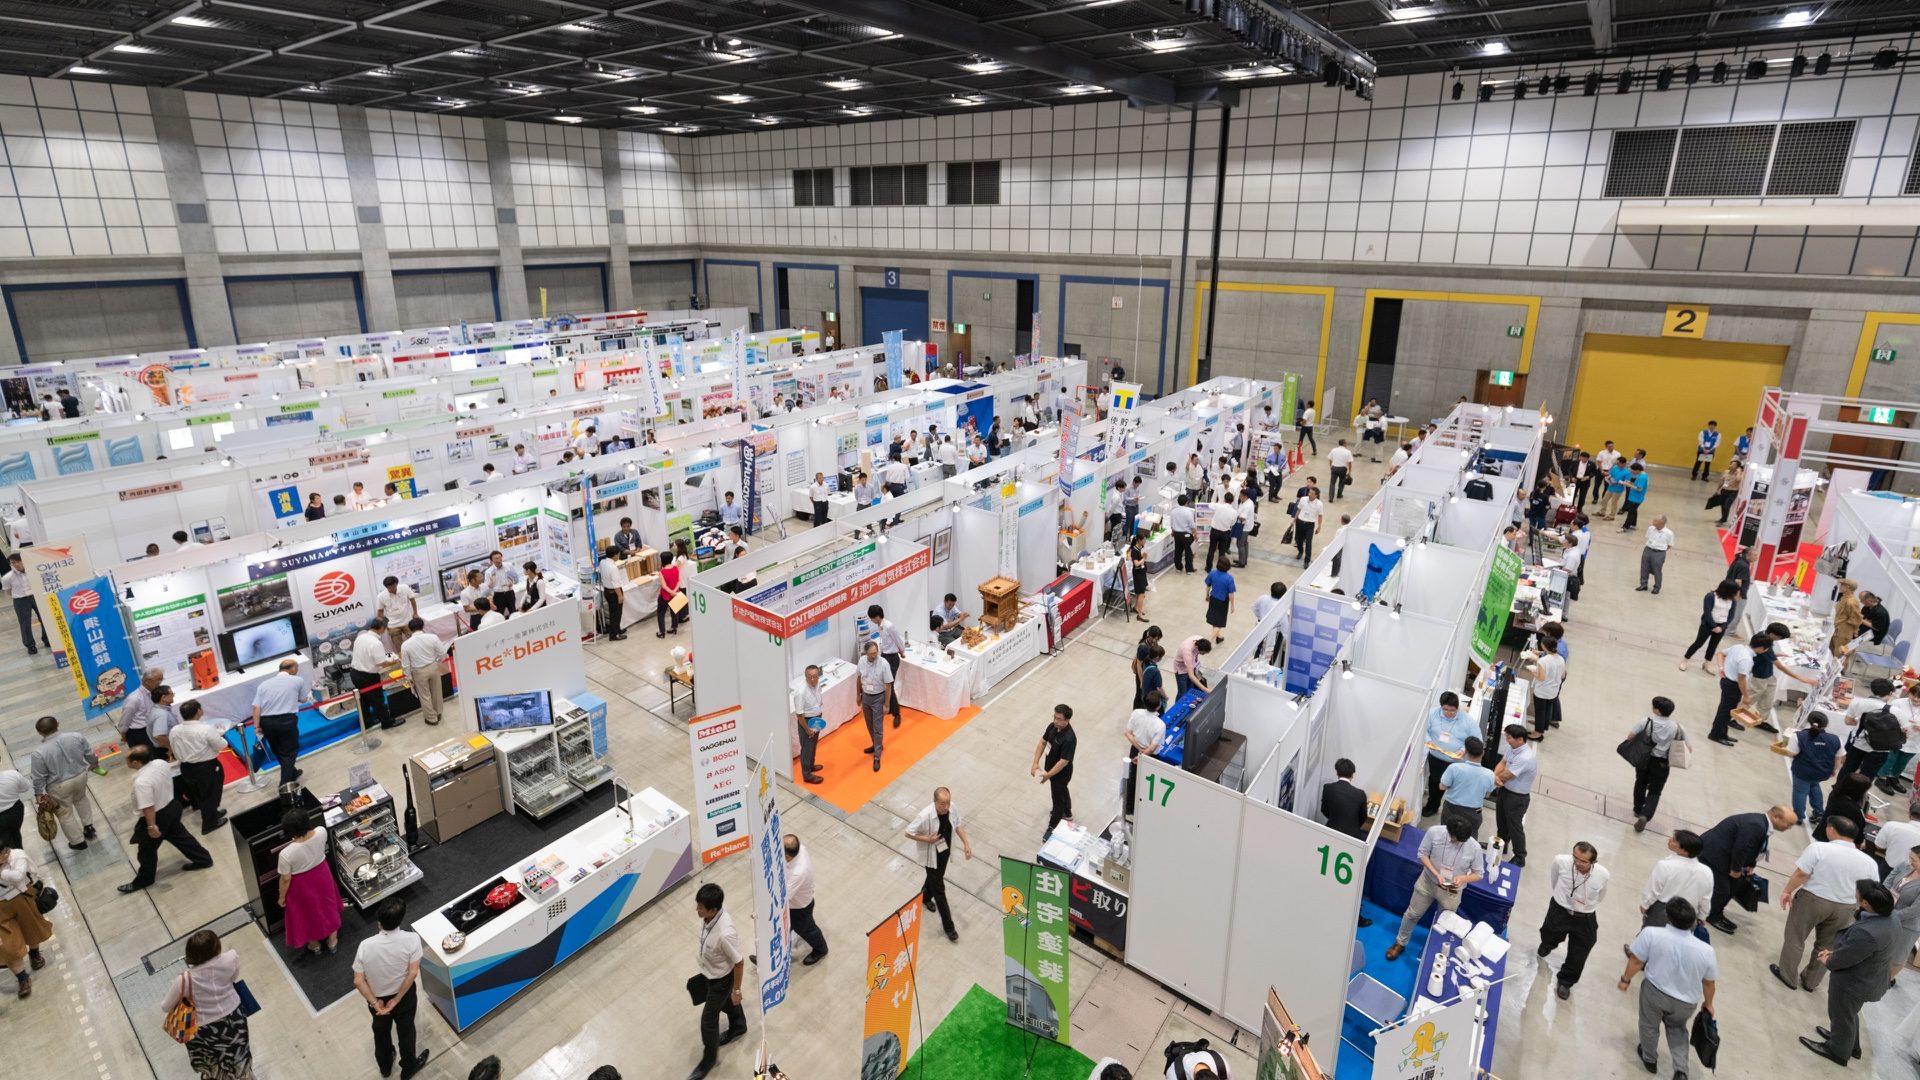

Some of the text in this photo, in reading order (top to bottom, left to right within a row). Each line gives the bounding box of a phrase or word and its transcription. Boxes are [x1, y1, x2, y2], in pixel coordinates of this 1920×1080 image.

[887, 270, 897, 285] 3
[932, 320, 946, 330] 禁煙
[1672, 309, 1696, 333] 2
[313, 601, 364, 622] SUYAMA
[692, 591, 707, 615] 19
[699, 721, 736, 739] Miele
[700, 736, 737, 752] GAGGENAU
[712, 749, 739, 763] BOSCH
[713, 779, 732, 790] AEG
[1145, 773, 1176, 807] 17
[705, 789, 740, 806] LIEBHERR
[1317, 844, 1354, 885] 16
